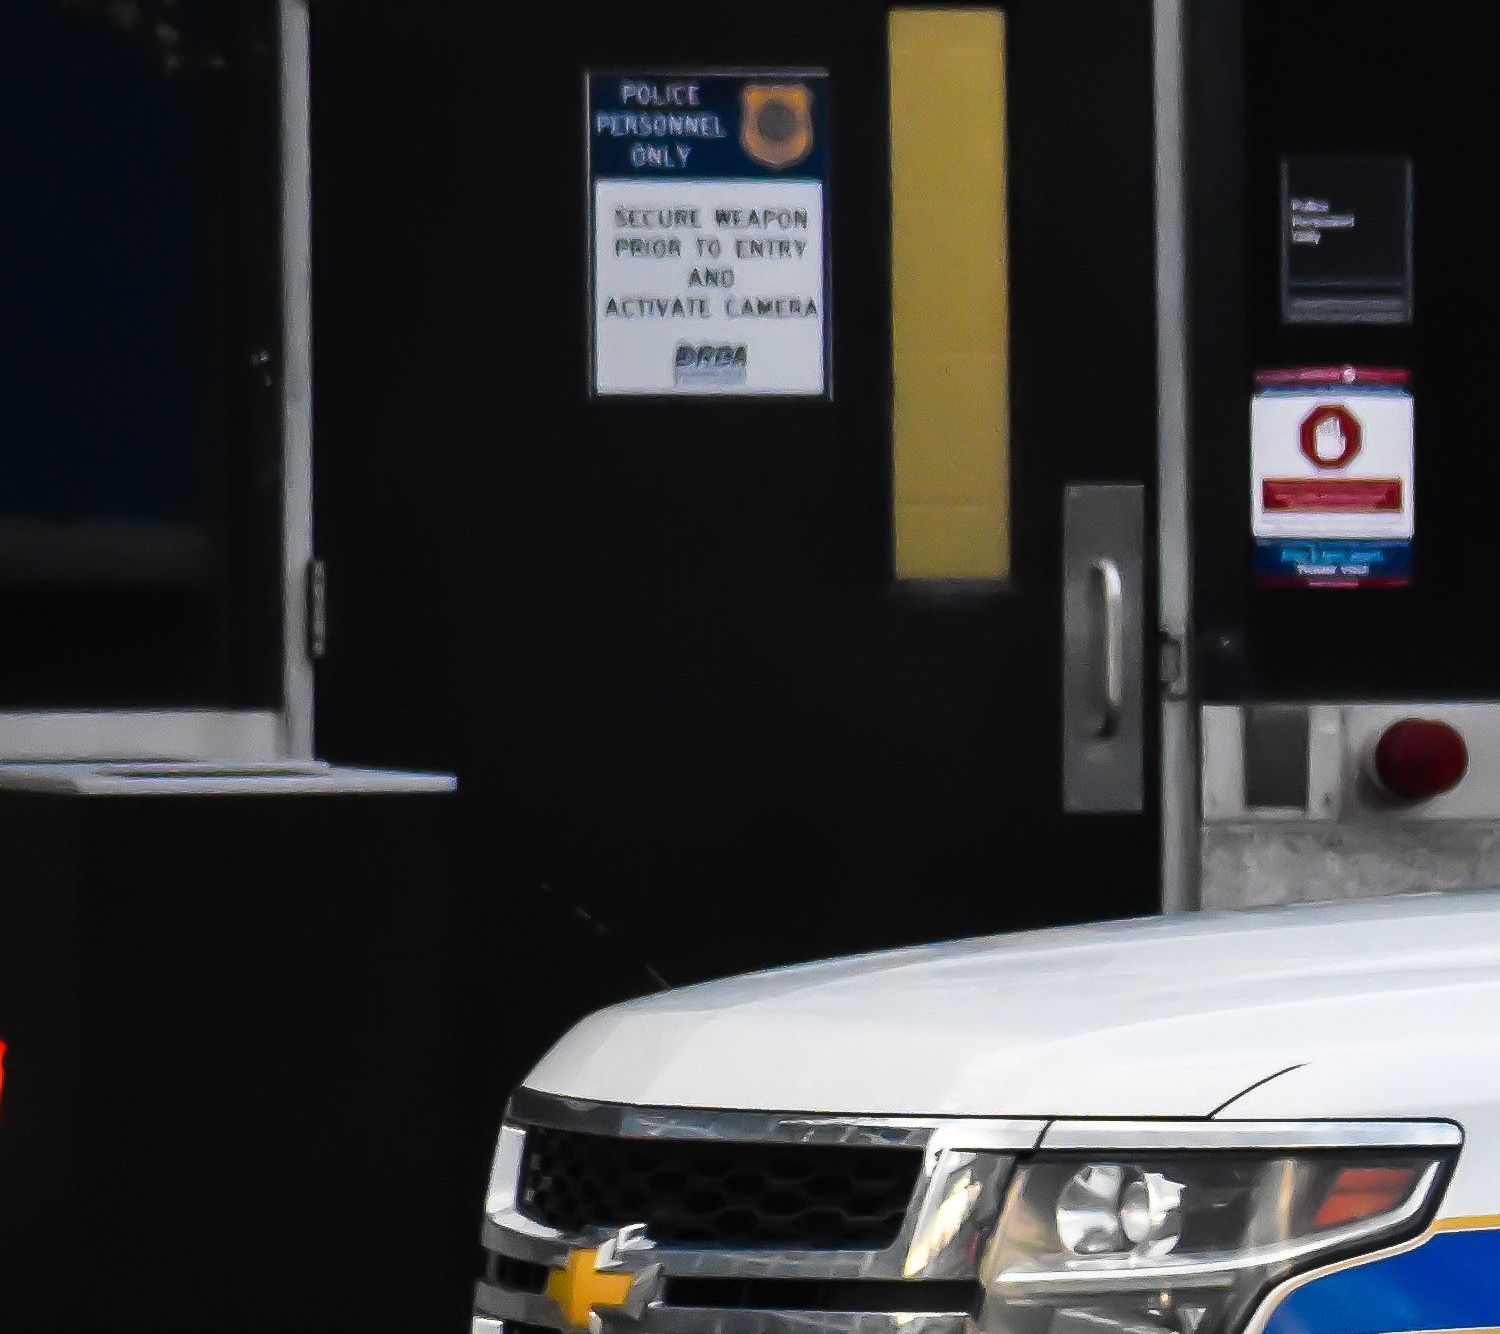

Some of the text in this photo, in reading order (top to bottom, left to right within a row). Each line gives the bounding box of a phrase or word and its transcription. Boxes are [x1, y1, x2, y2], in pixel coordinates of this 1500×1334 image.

[622, 84, 700, 107] POLICE
[597, 115, 726, 138] PERSONNEL
[631, 144, 692, 168] ONLY
[614, 208, 808, 229] SECURE WEAPON
[614, 237, 807, 258] PRIOR TO ENTRY
[688, 267, 735, 288] AND
[606, 297, 818, 318] ACTIVATE CAMERA
